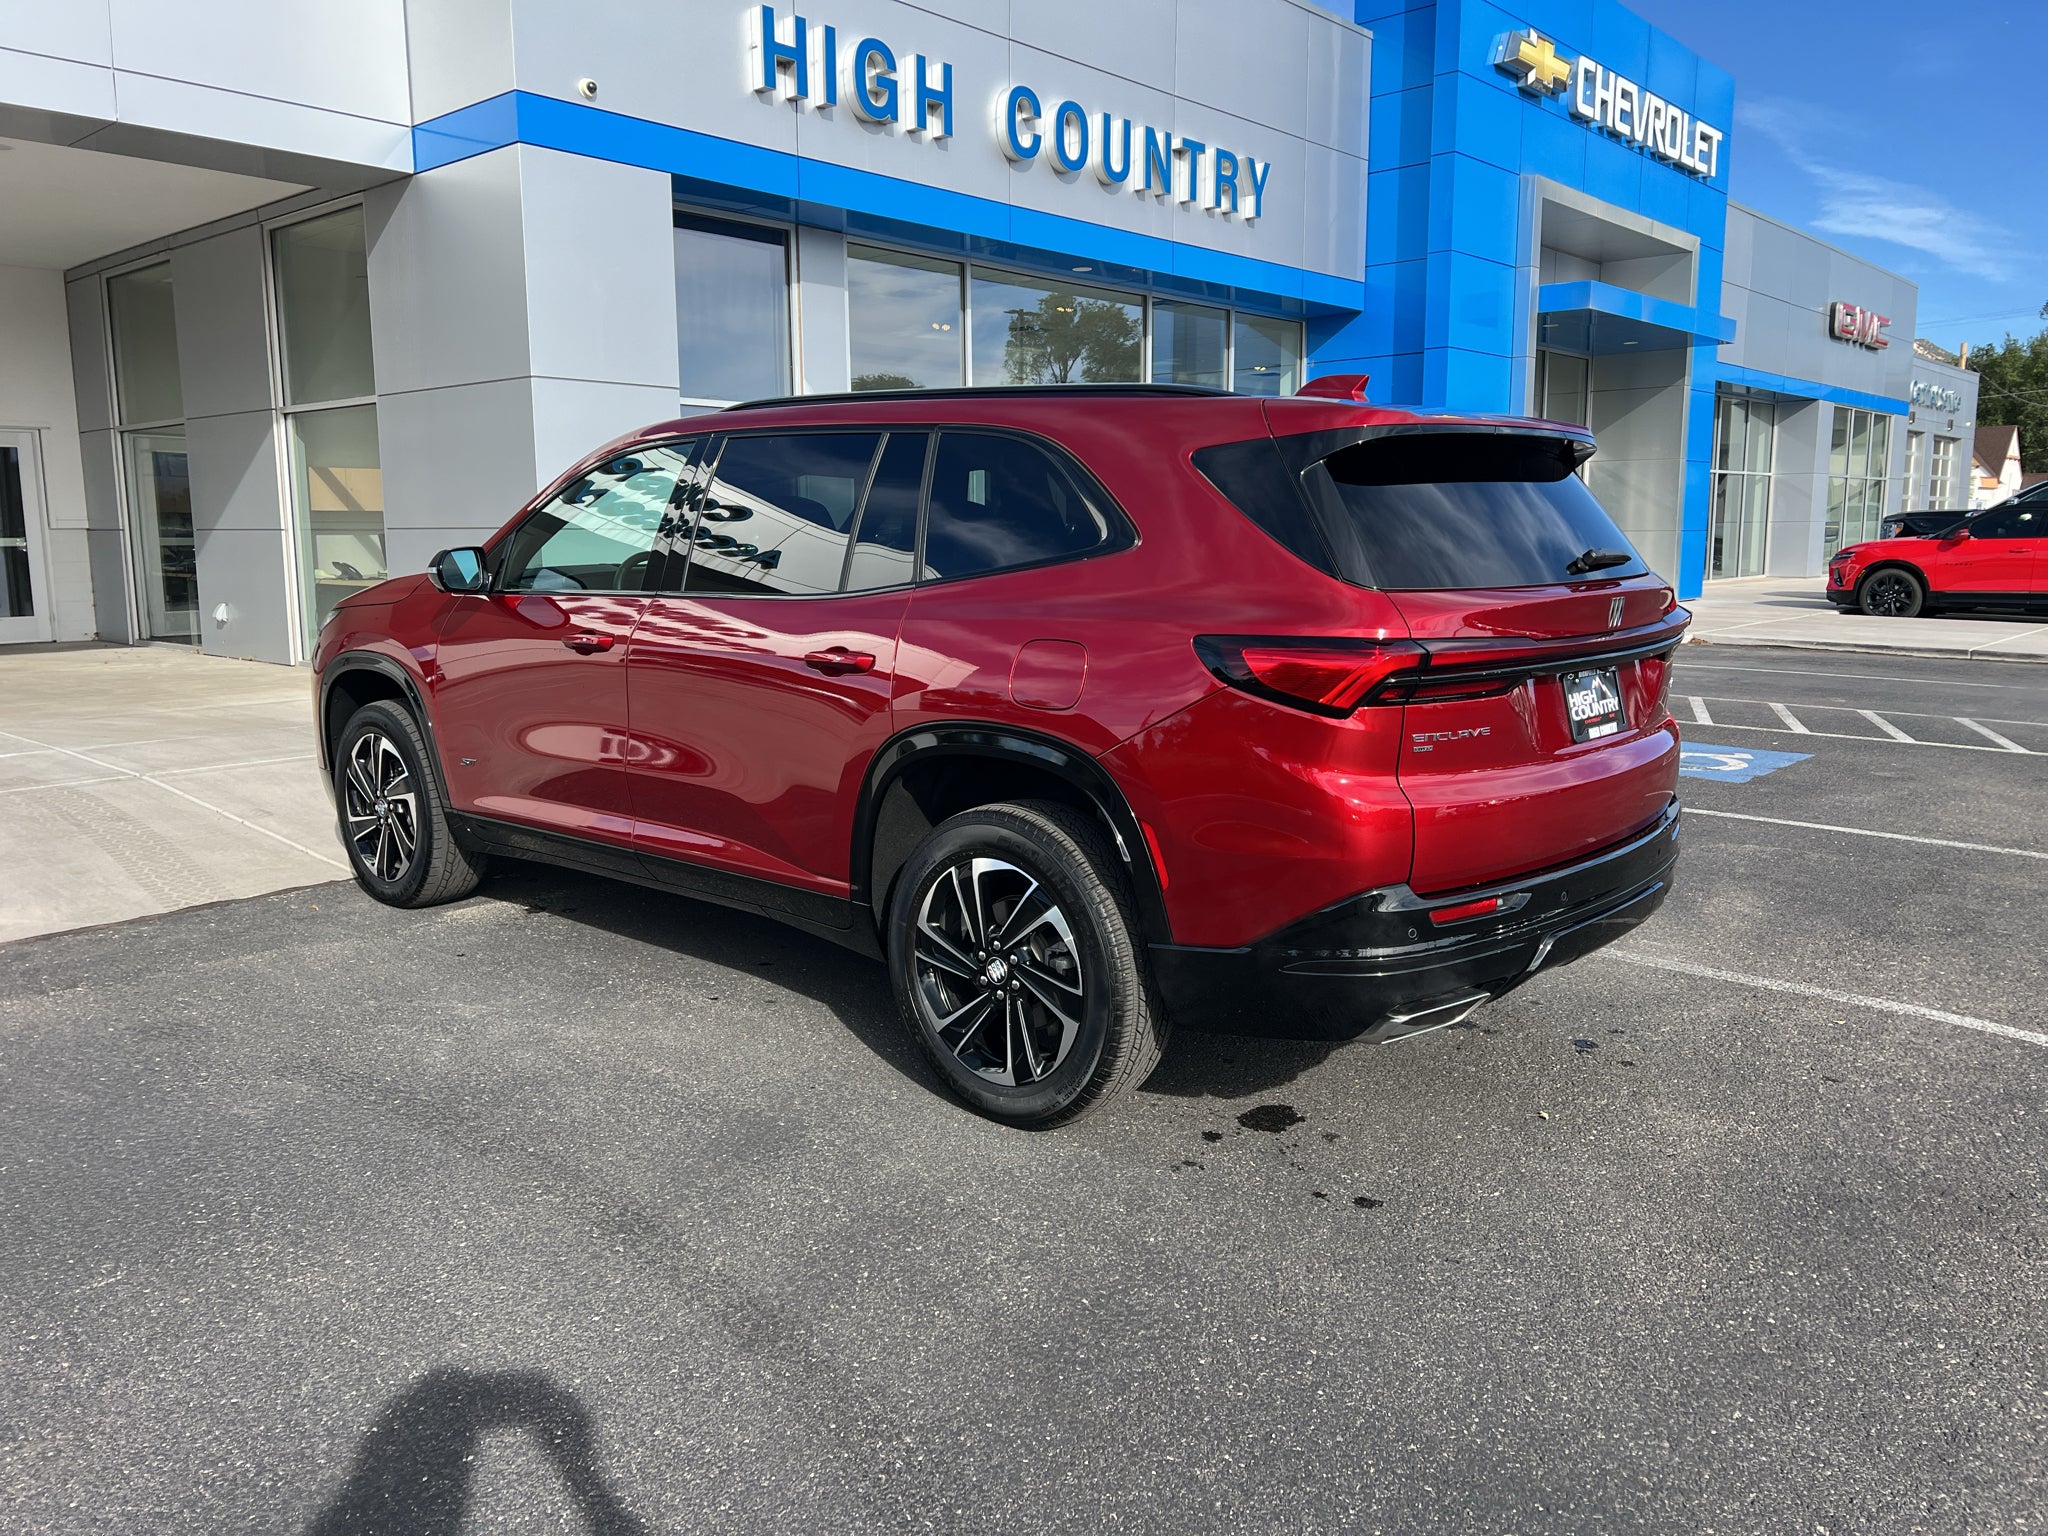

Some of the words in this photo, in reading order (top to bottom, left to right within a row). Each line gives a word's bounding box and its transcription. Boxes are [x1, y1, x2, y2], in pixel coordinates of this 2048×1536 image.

[753, 4, 954, 140] HIGH
[996, 84, 1271, 220] COUNTRY
[1572, 54, 1723, 178] CHEVROLET
[1832, 301, 1892, 350] GMC
[1567, 689, 1598, 708] HIGH
[1571, 696, 1619, 721] COUNTRY
[1411, 726, 1491, 743] ENCLAVE
